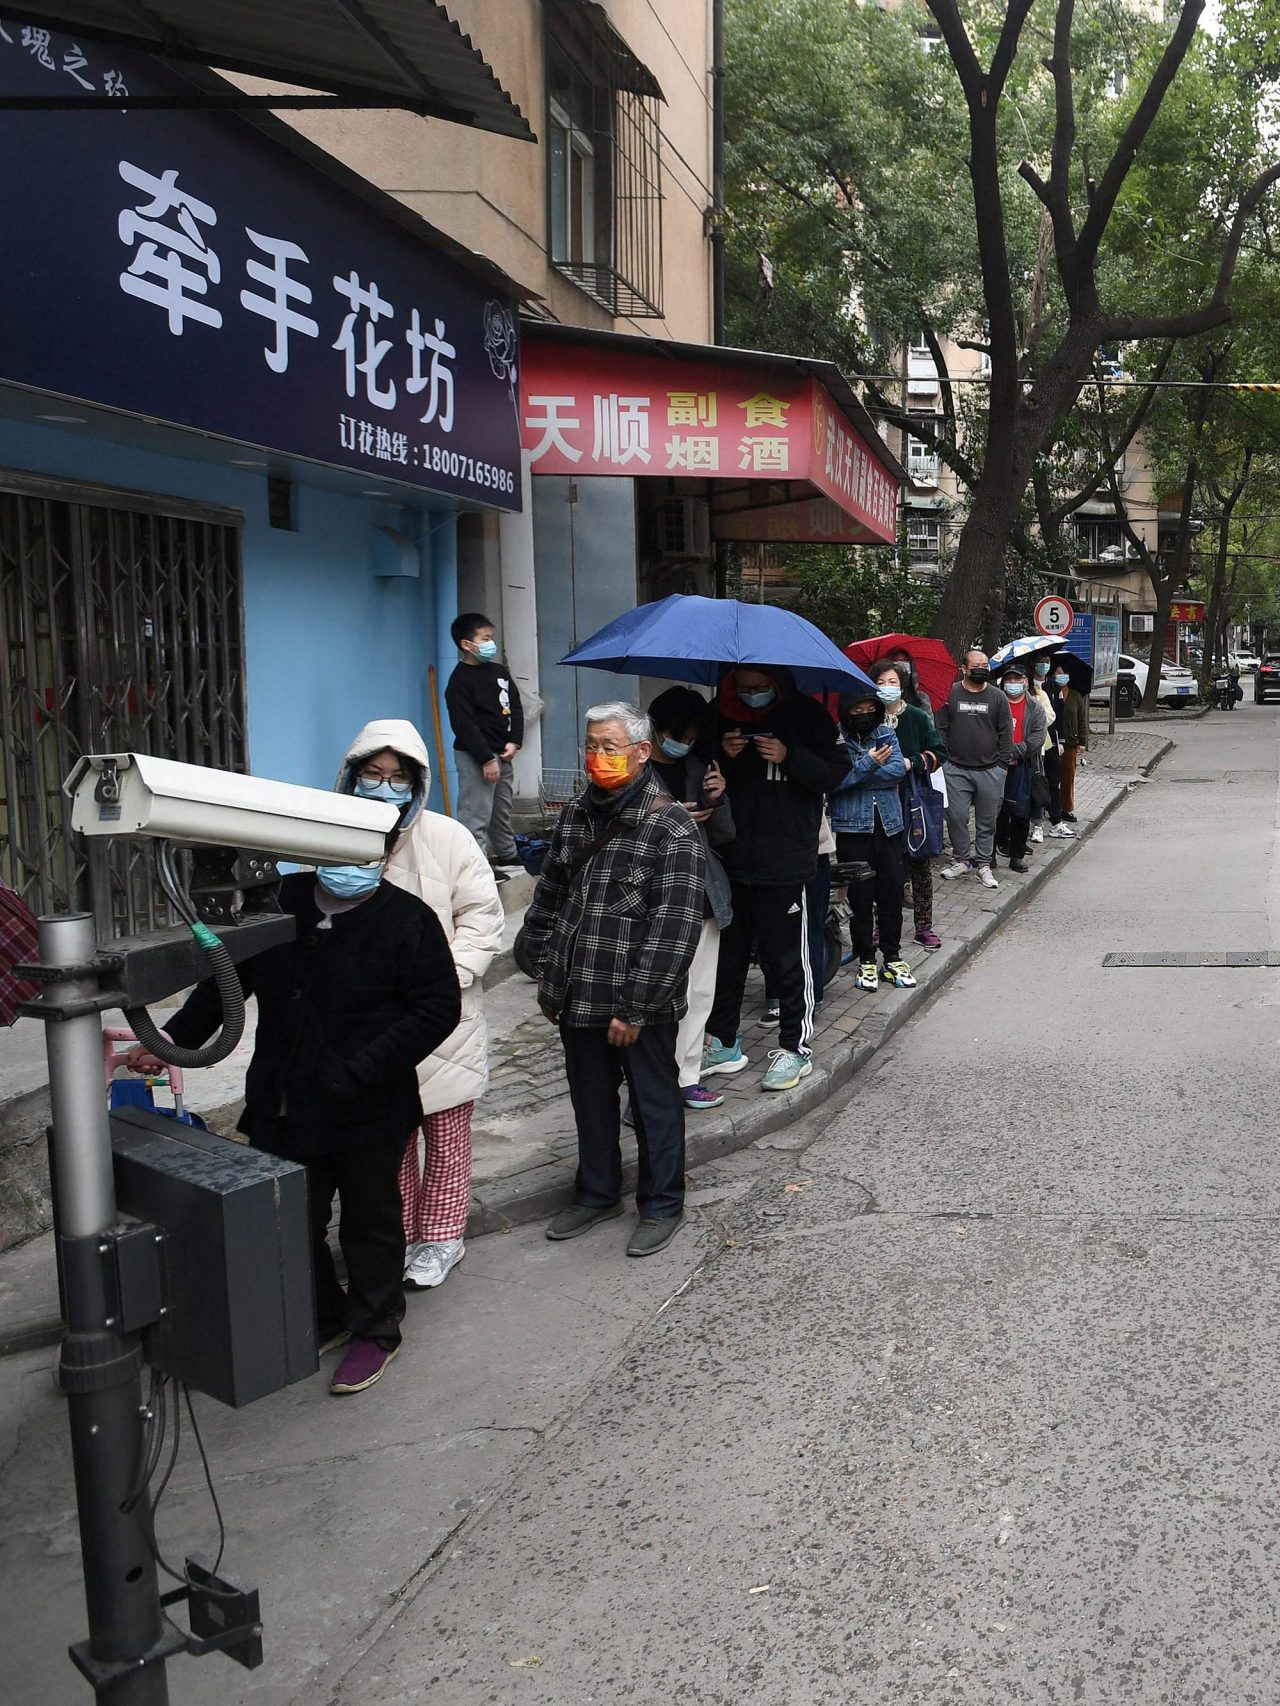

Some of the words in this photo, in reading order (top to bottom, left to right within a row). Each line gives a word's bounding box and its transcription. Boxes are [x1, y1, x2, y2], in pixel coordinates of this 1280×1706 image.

[118, 160, 457, 432] 牵手花坊
[525, 393, 652, 465] 天顺
[665, 391, 792, 429] 副食
[665, 435, 790, 472] 烟酒
[1049, 606, 1060, 623] 5
